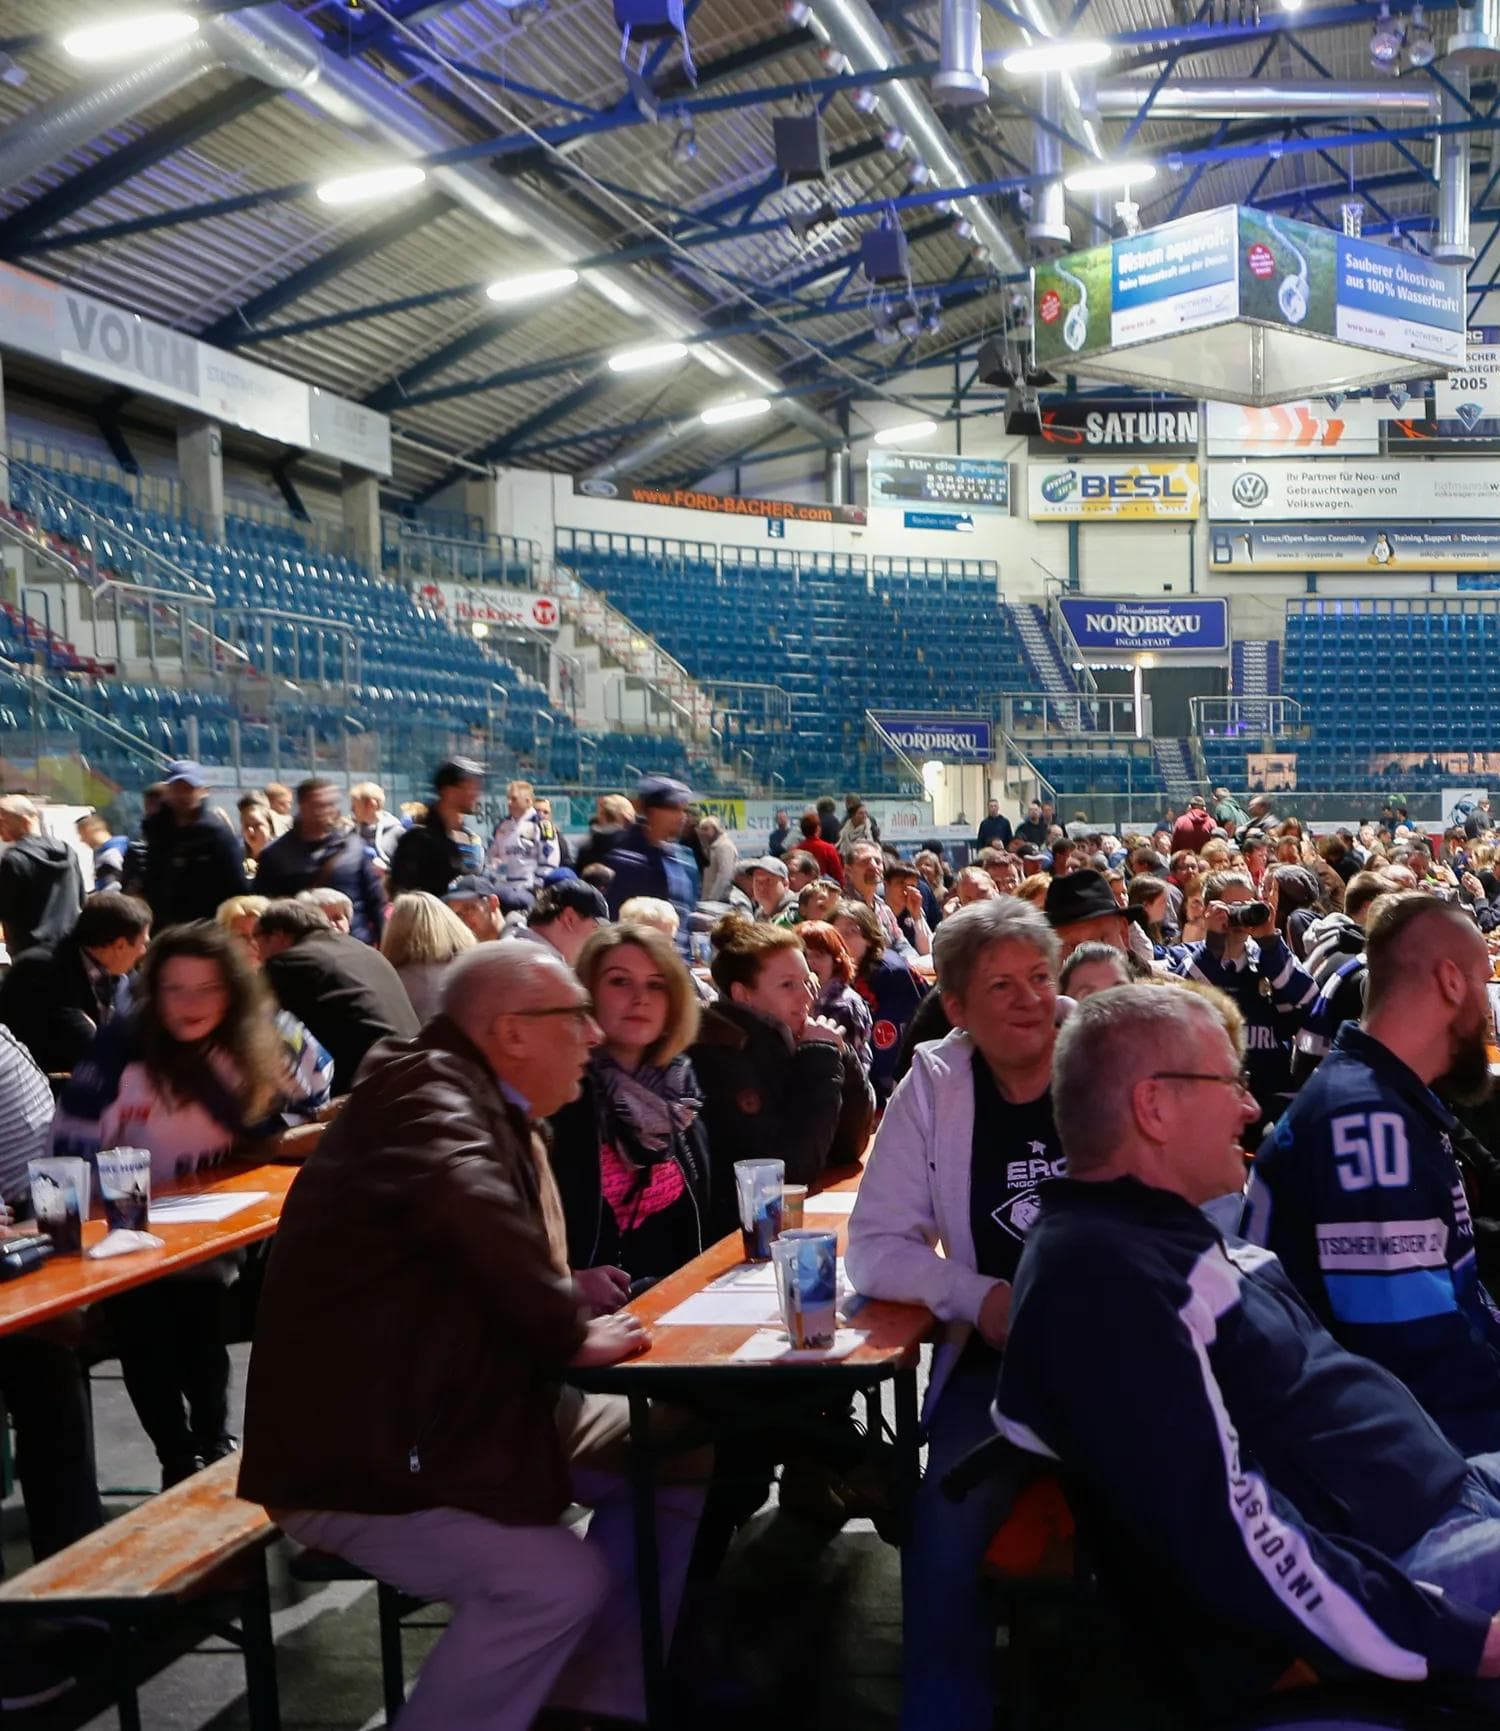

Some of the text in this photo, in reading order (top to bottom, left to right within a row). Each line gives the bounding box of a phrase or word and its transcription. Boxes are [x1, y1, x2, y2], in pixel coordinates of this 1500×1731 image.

[1344, 253, 1446, 291] Sauberer Ökostrom
[1345, 273, 1364, 289] aus
[1397, 284, 1460, 313] Wasserkraft!
[66, 296, 199, 397] VOITH
[1466, 352, 1497, 361] SCHER
[1450, 377, 1488, 390] 2005
[1085, 411, 1198, 444] SATURN
[1081, 475, 1188, 498] BESL
[1301, 471, 1337, 482] Partner
[1339, 471, 1353, 482] für
[1381, 471, 1400, 482] und
[1286, 484, 1398, 497] Gebrauchtwagen von
[632, 488, 833, 522] www.FORD-BACHER.com
[1286, 499, 1354, 511] Volkswagen.
[1085, 613, 1202, 637] NORDBRÄU
[1115, 637, 1172, 648] INGOLSTADT
[889, 732, 978, 750] NORDBRÄU
[1330, 1111, 1410, 1191] 50
[1319, 1236, 1377, 1256] TSCHER
